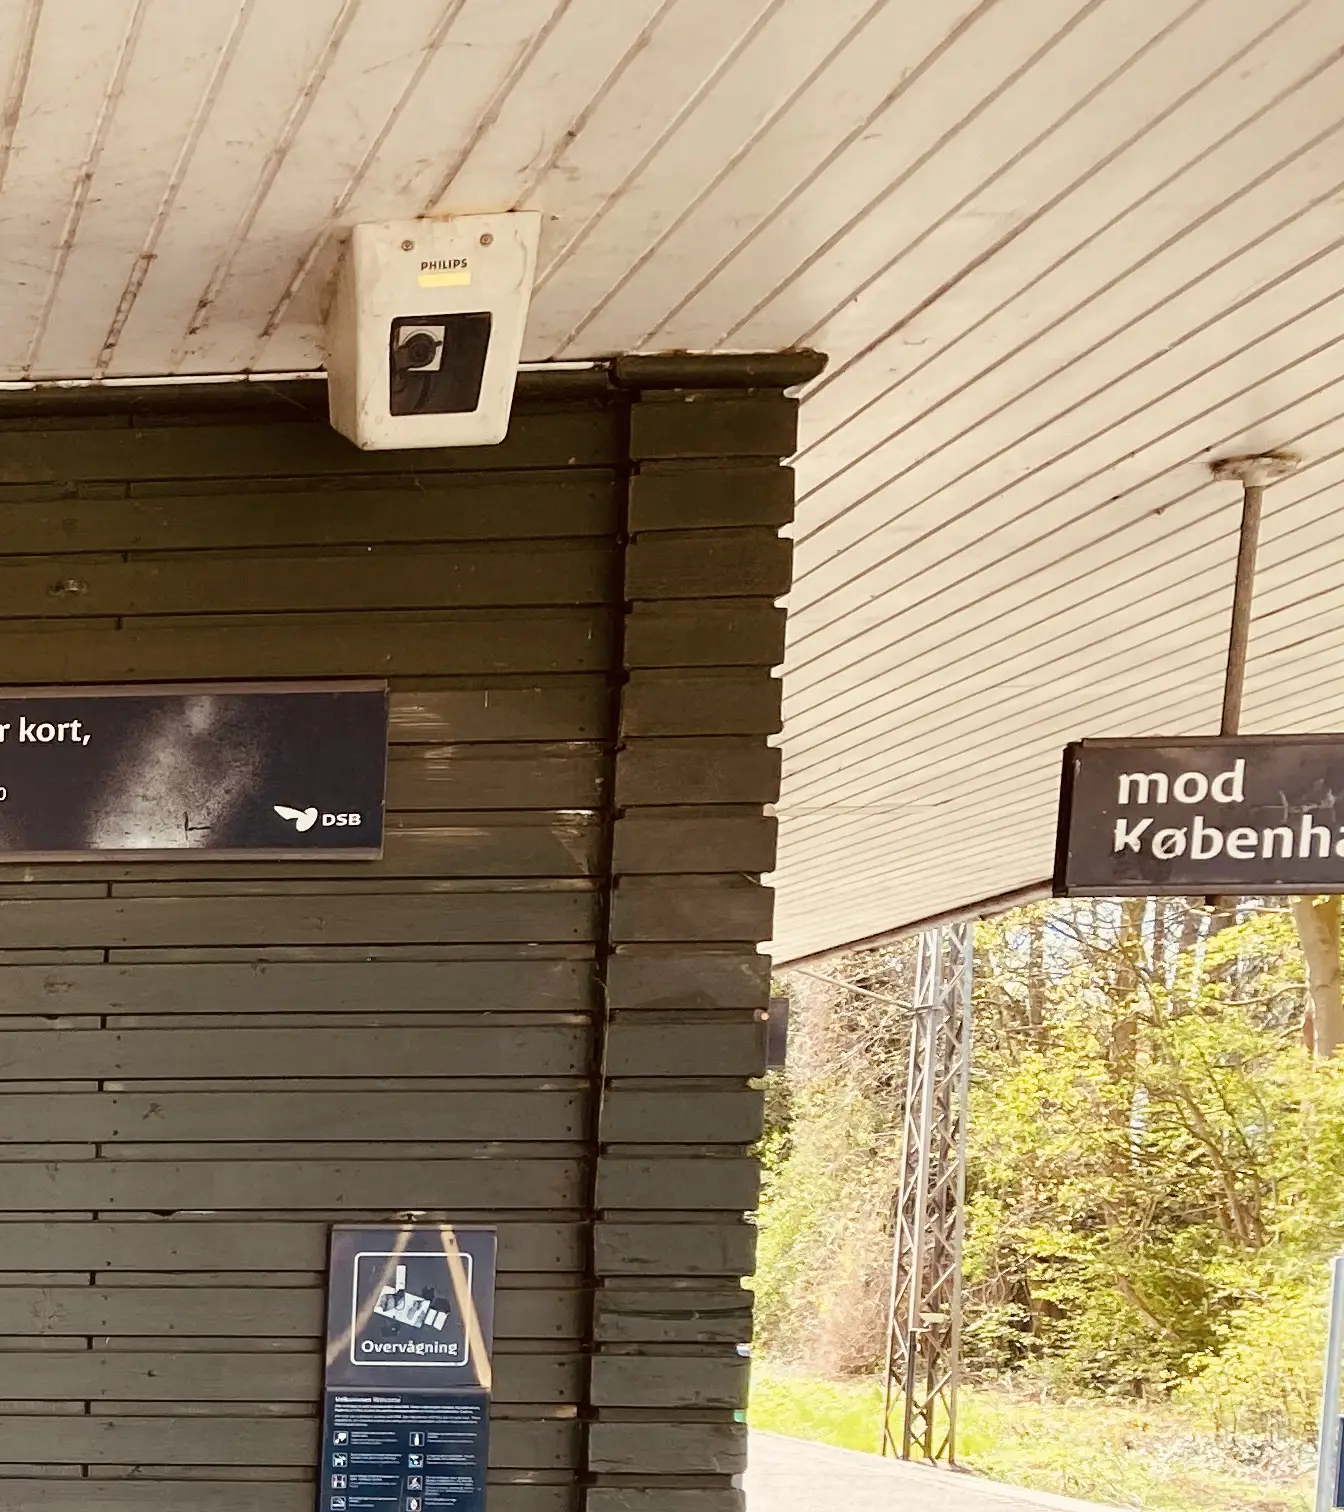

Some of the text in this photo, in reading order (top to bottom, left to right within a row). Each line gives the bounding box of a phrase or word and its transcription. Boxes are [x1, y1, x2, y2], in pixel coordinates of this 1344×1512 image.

[420, 258, 468, 271] PHILIPS
[18, 716, 91, 746] kort,
[1118, 758, 1246, 805] mod
[322, 813, 362, 827] DSB
[1114, 813, 1344, 861] Københ
[360, 1338, 458, 1357] Overvågning
